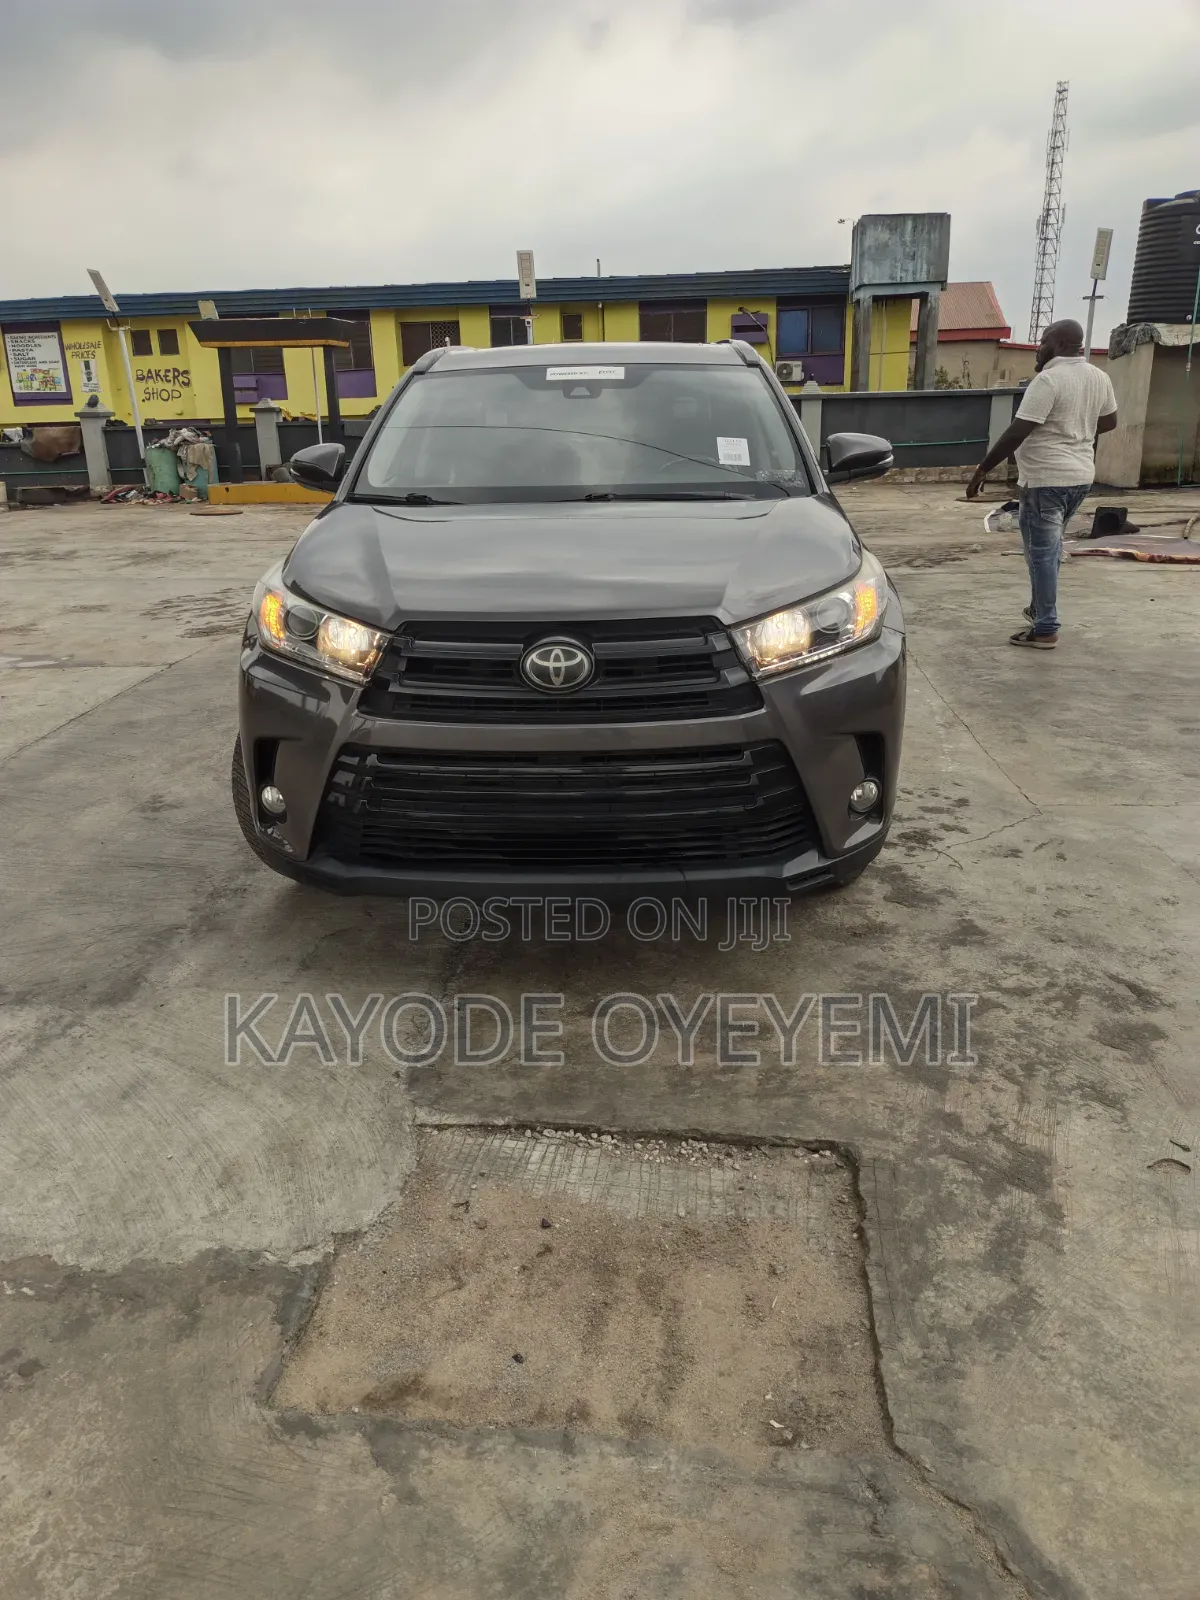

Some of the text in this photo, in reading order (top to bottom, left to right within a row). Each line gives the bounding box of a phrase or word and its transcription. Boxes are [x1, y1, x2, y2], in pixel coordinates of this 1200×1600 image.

[65, 340, 102, 351] WHOLESALE
[71, 350, 96, 360] PRICES
[135, 367, 192, 388] BAKERS
